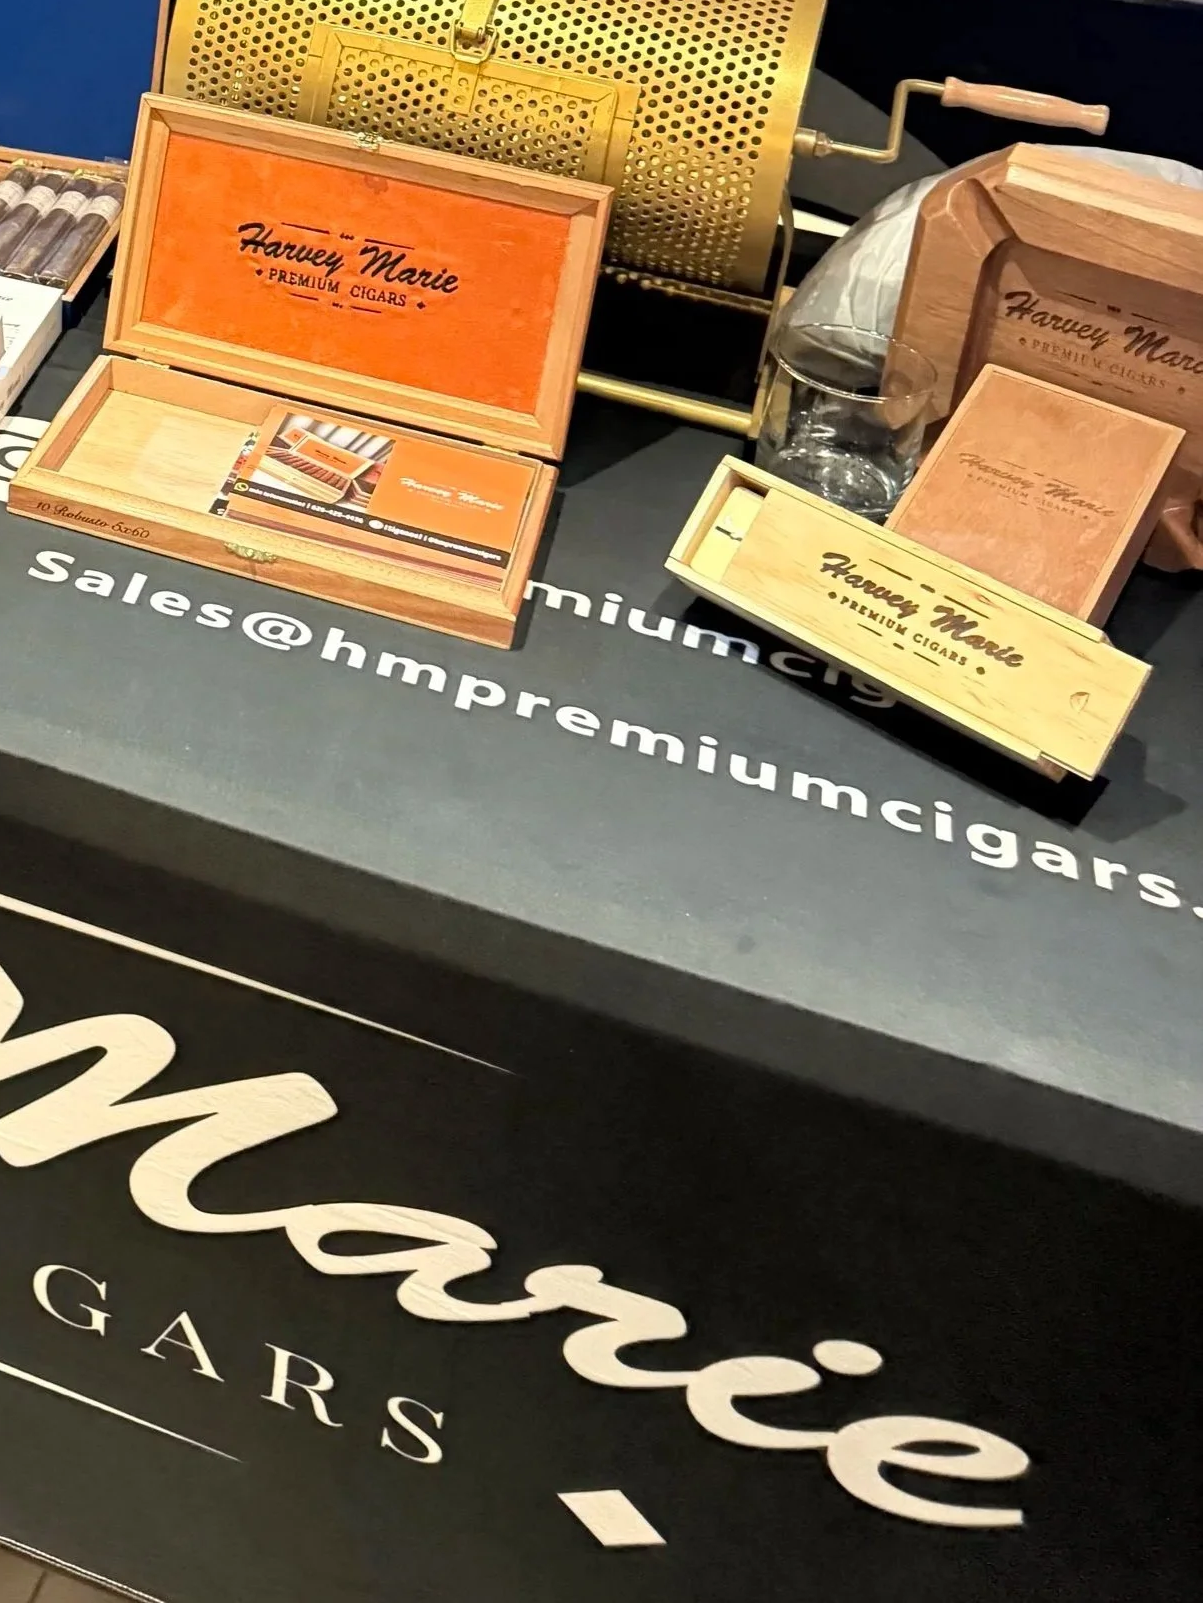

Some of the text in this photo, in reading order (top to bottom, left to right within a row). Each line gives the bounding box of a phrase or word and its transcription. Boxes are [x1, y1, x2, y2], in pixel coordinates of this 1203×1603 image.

[237, 222, 459, 294] Harvey Marie
[268, 268, 407, 307] PREMIUM CIGARS
[1005, 290, 1110, 351] Harvey
[1032, 338, 1168, 389] PREMIUM CIGARS
[959, 452, 1117, 517] Harvey Marie
[36, 501, 150, 539] 10 Robusto 5x60
[820, 551, 1024, 668] Harvey Marie
[840, 595, 968, 666] PREMIUM CIGARS
